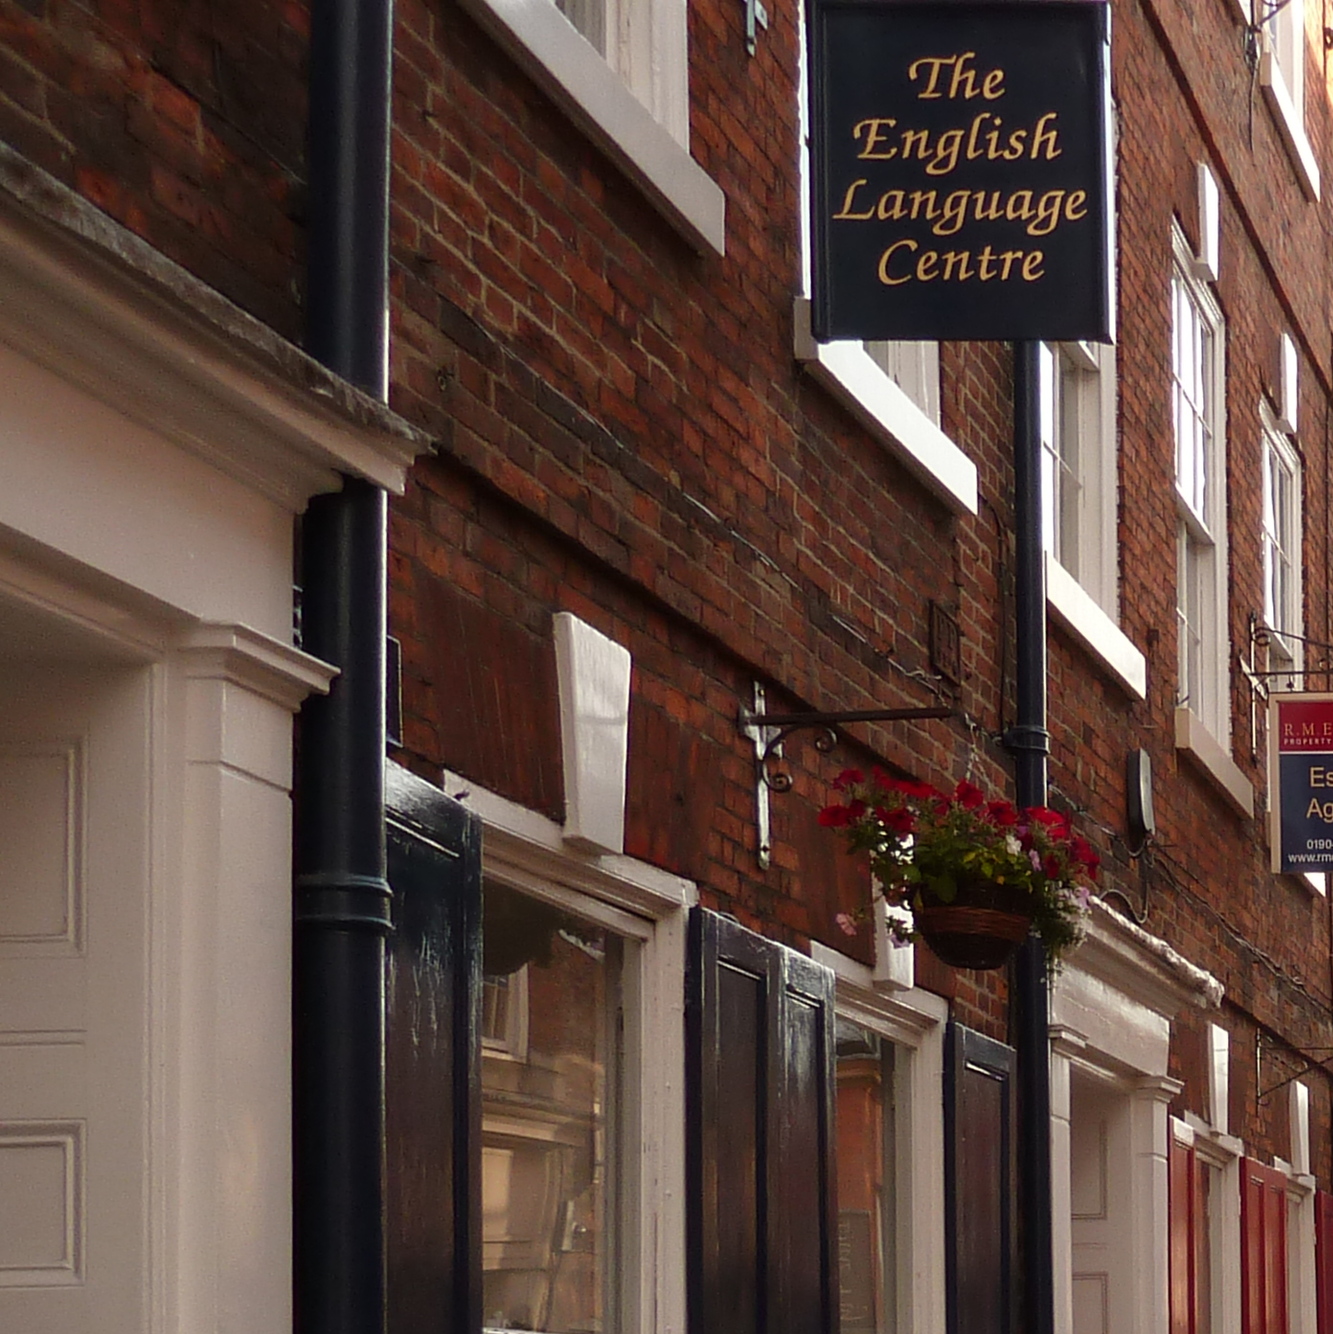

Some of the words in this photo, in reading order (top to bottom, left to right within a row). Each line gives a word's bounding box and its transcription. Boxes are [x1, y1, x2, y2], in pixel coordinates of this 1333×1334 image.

[908, 52, 1006, 100] The
[853, 112, 1062, 176] English
[832, 179, 1088, 236] Language
[877, 239, 1045, 285] Centre
[1283, 737, 1332, 746] PROPERTY
